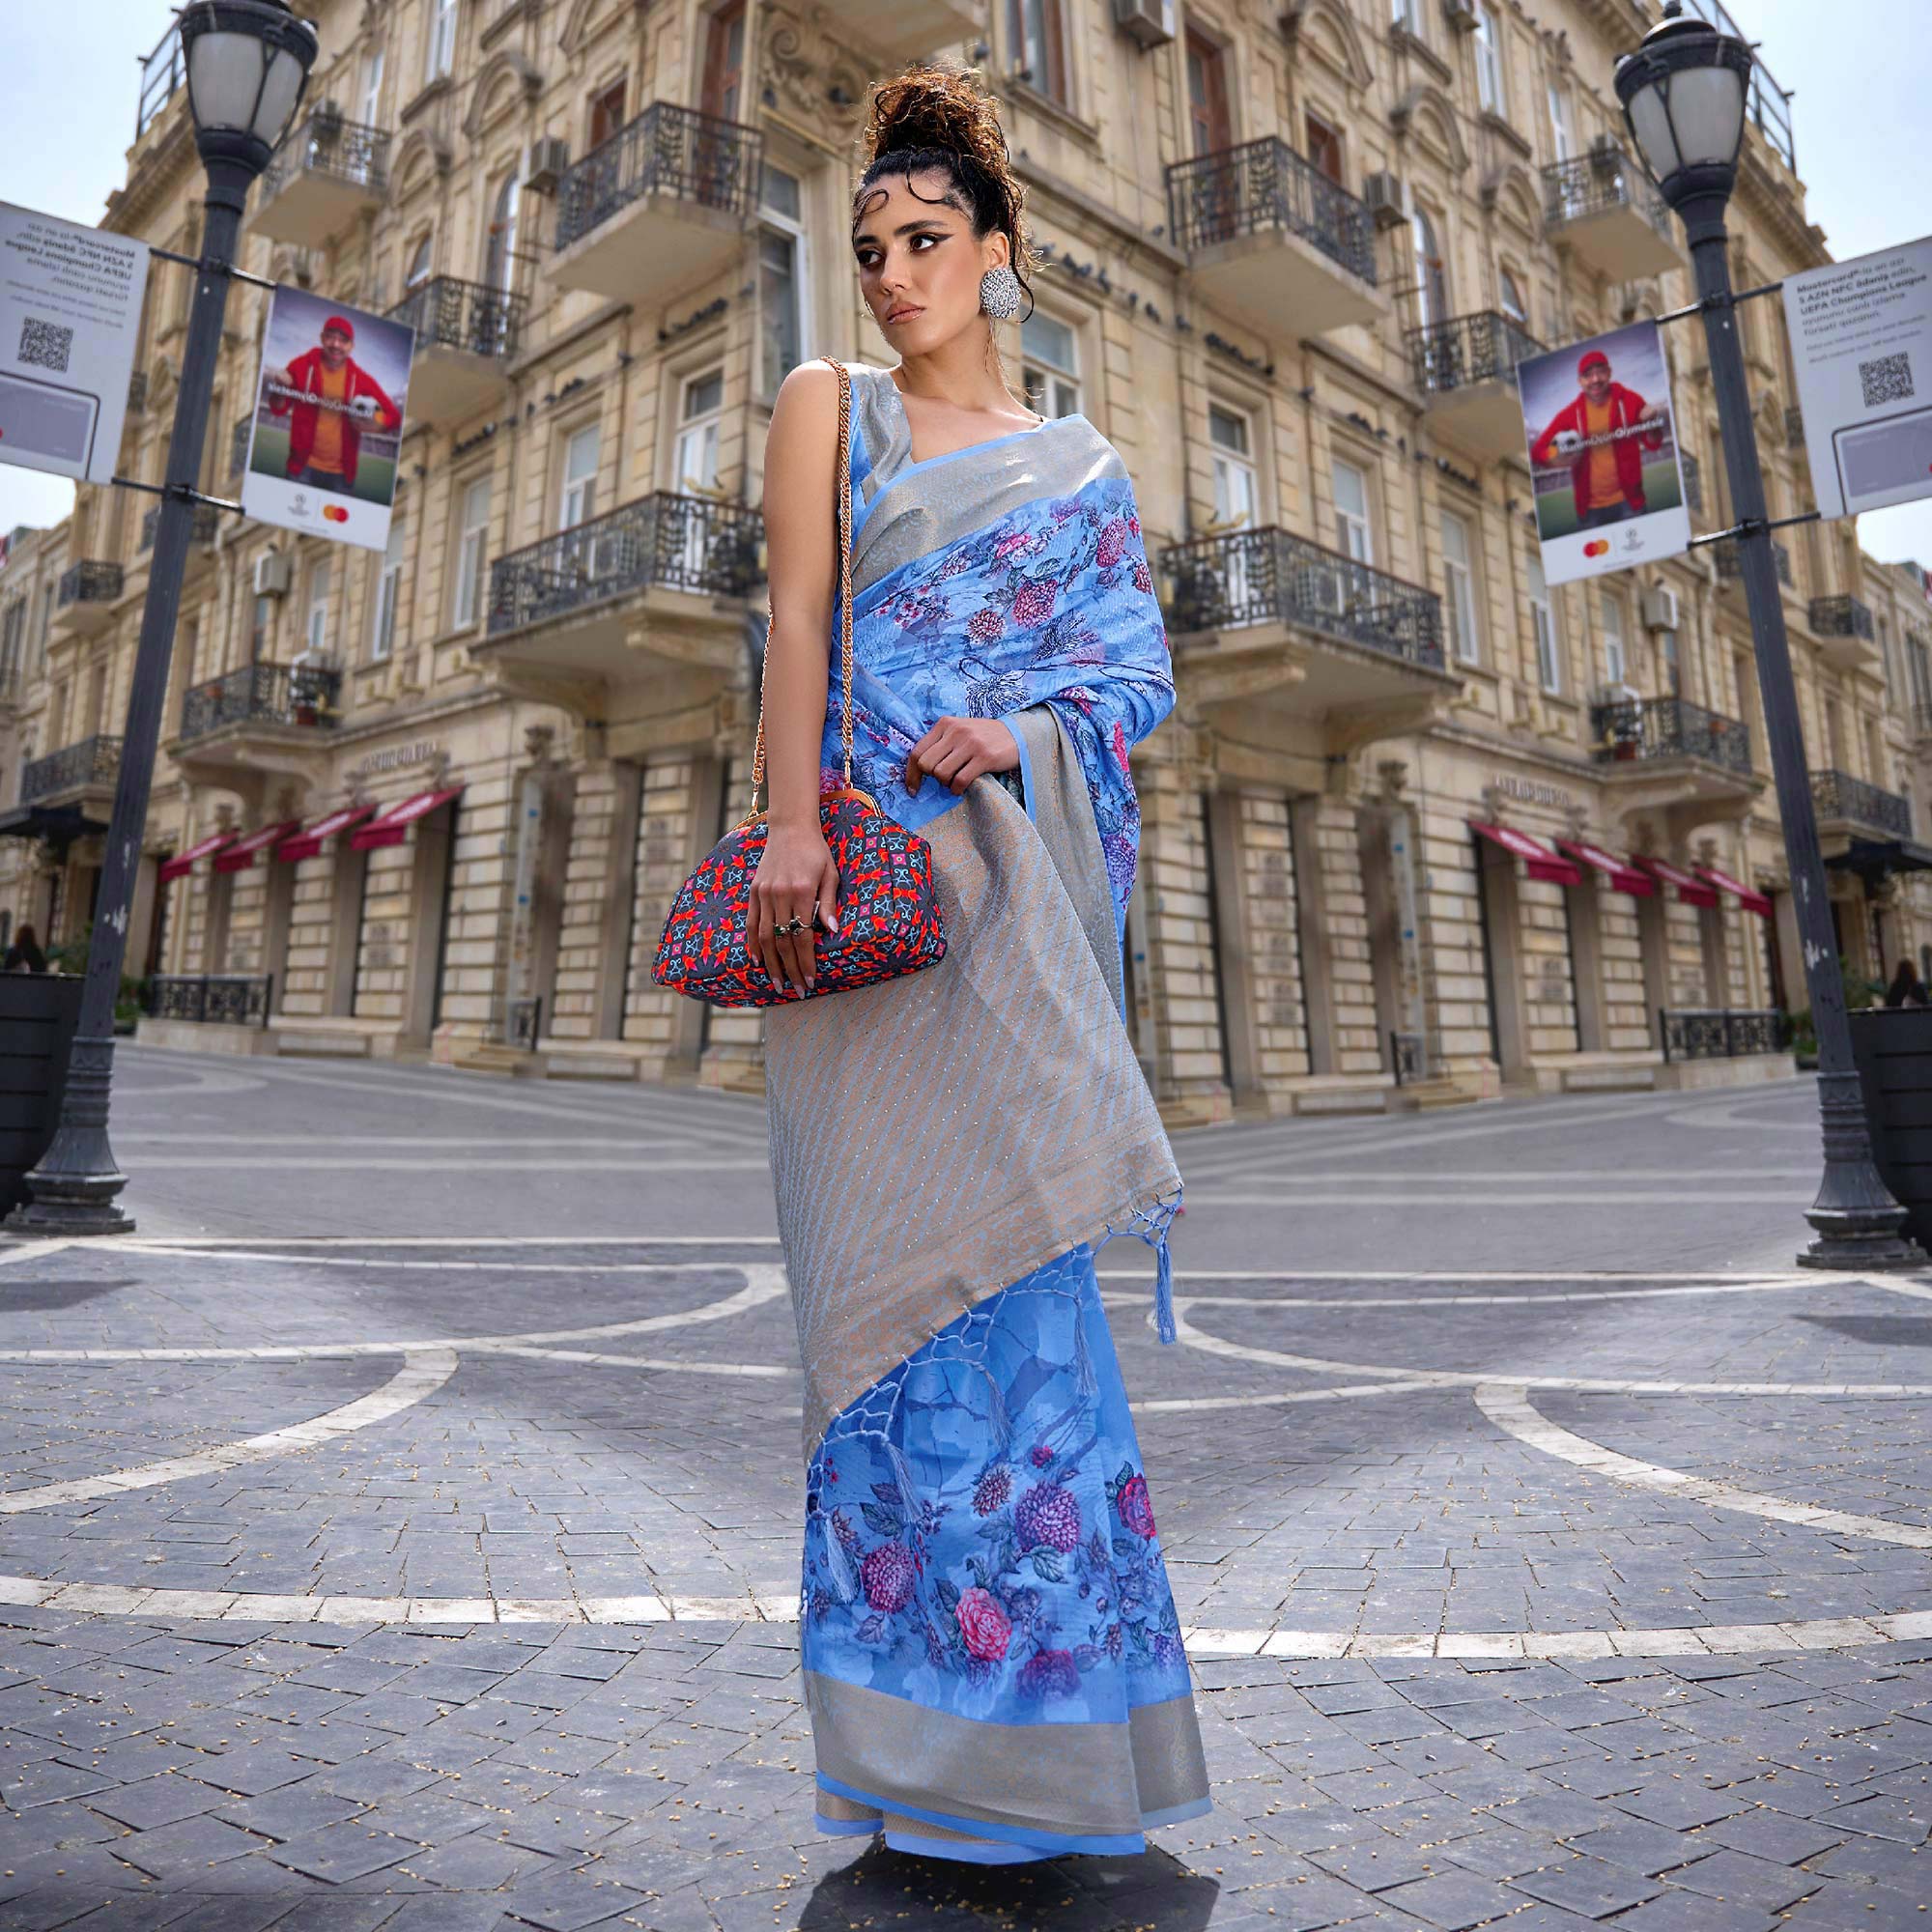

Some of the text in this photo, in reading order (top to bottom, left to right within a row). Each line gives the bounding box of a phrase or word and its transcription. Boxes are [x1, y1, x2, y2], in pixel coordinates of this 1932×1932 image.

[1801, 273, 1927, 315] UEFA Champions League
[1807, 290, 1829, 302] AZN
